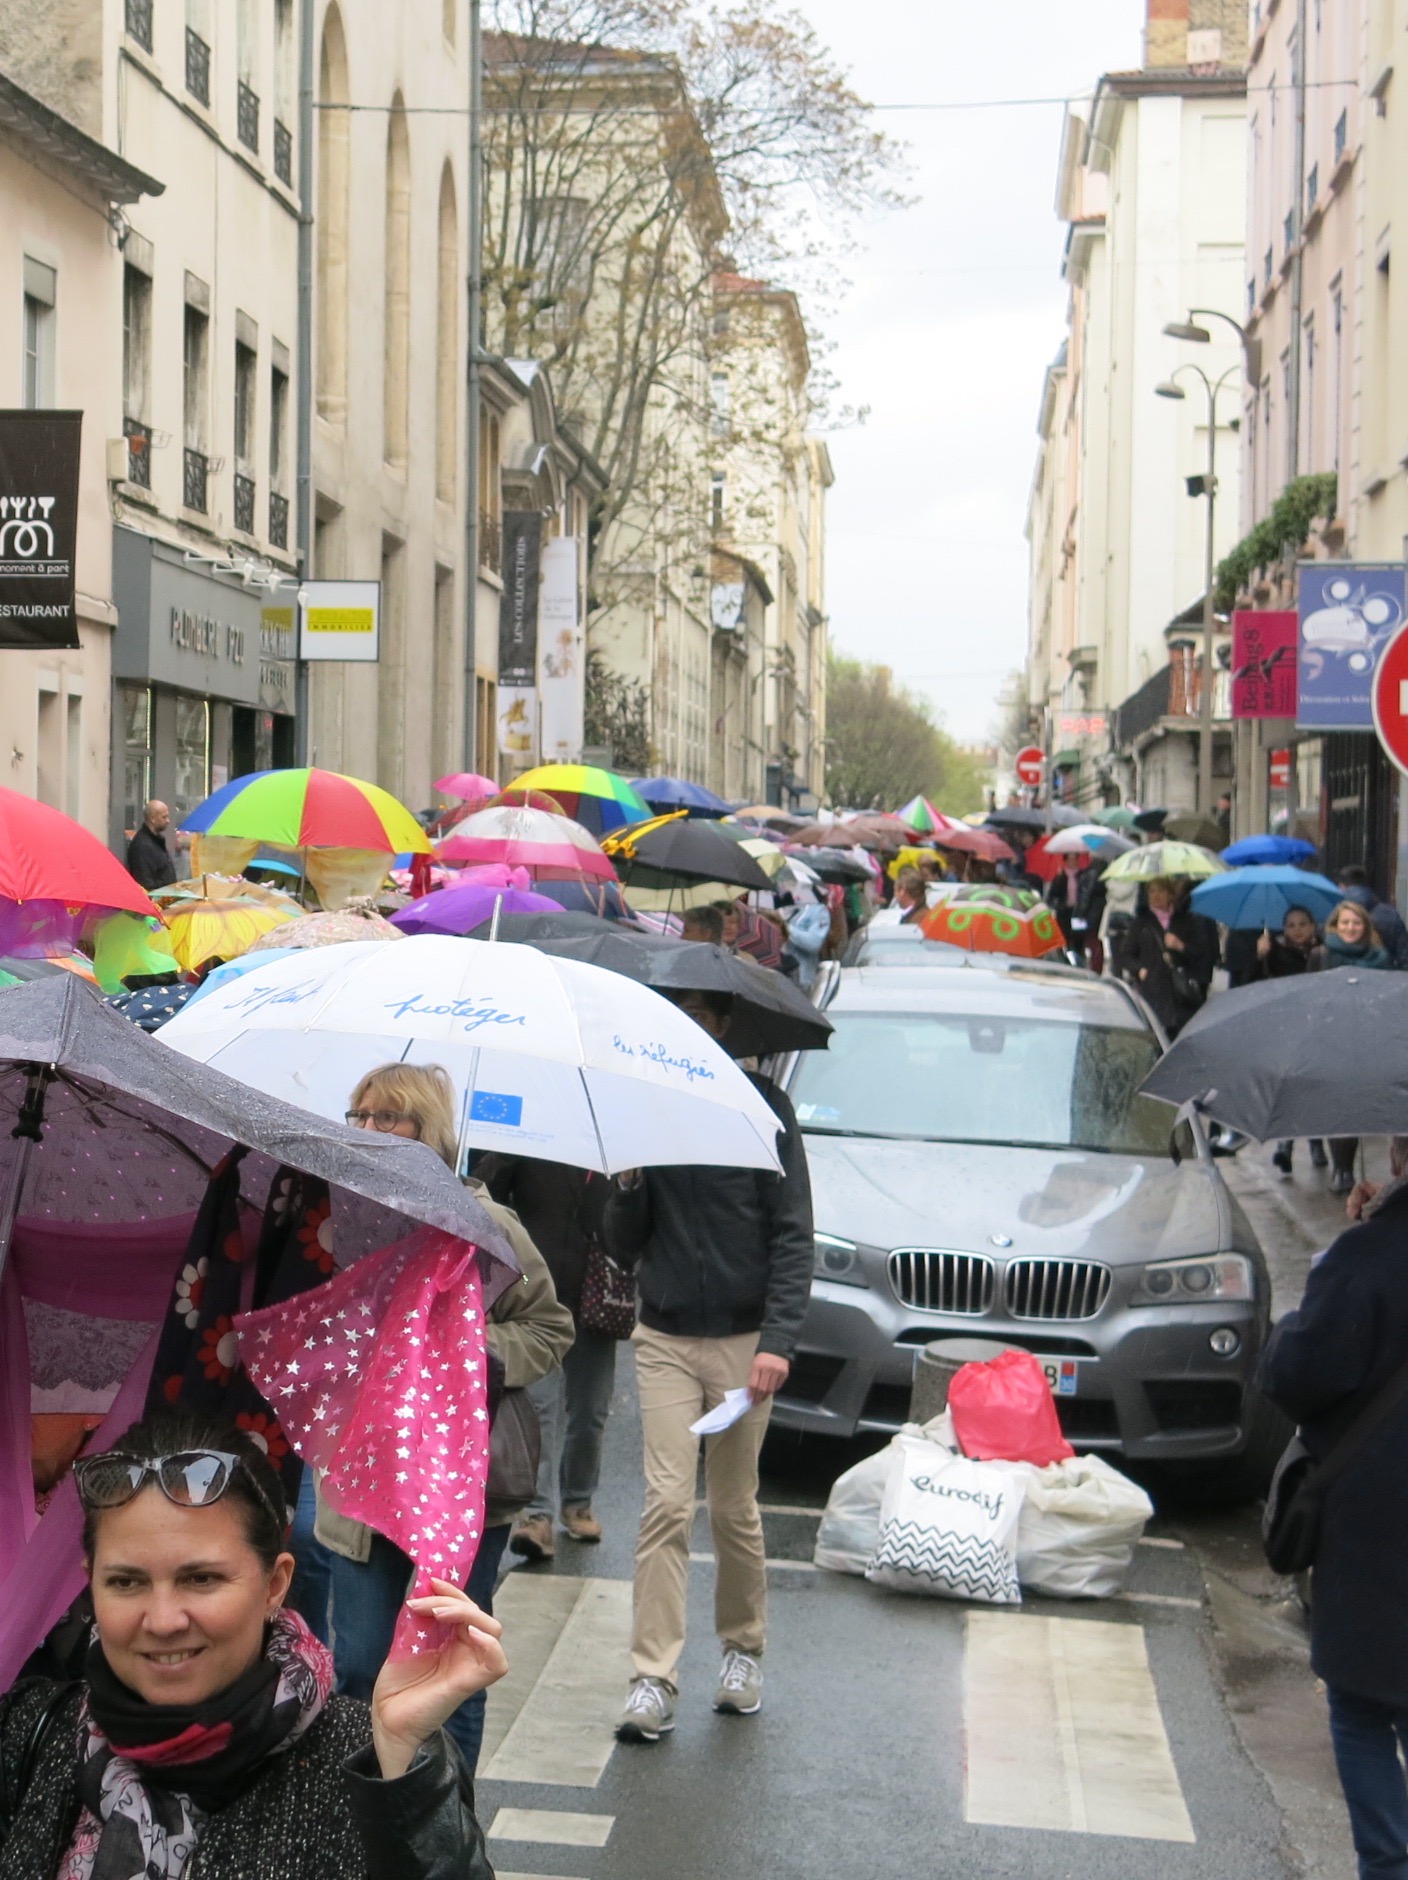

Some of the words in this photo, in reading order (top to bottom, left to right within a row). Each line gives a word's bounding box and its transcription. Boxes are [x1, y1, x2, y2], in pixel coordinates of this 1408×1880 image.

[37, 563, 45, 573] à
[46, 563, 70, 574] part
[1243, 629, 1264, 711] Beijng8
[383, 993, 526, 1032] protéger
[613, 1034, 635, 1056] les
[639, 1041, 715, 1083] réfugiés
